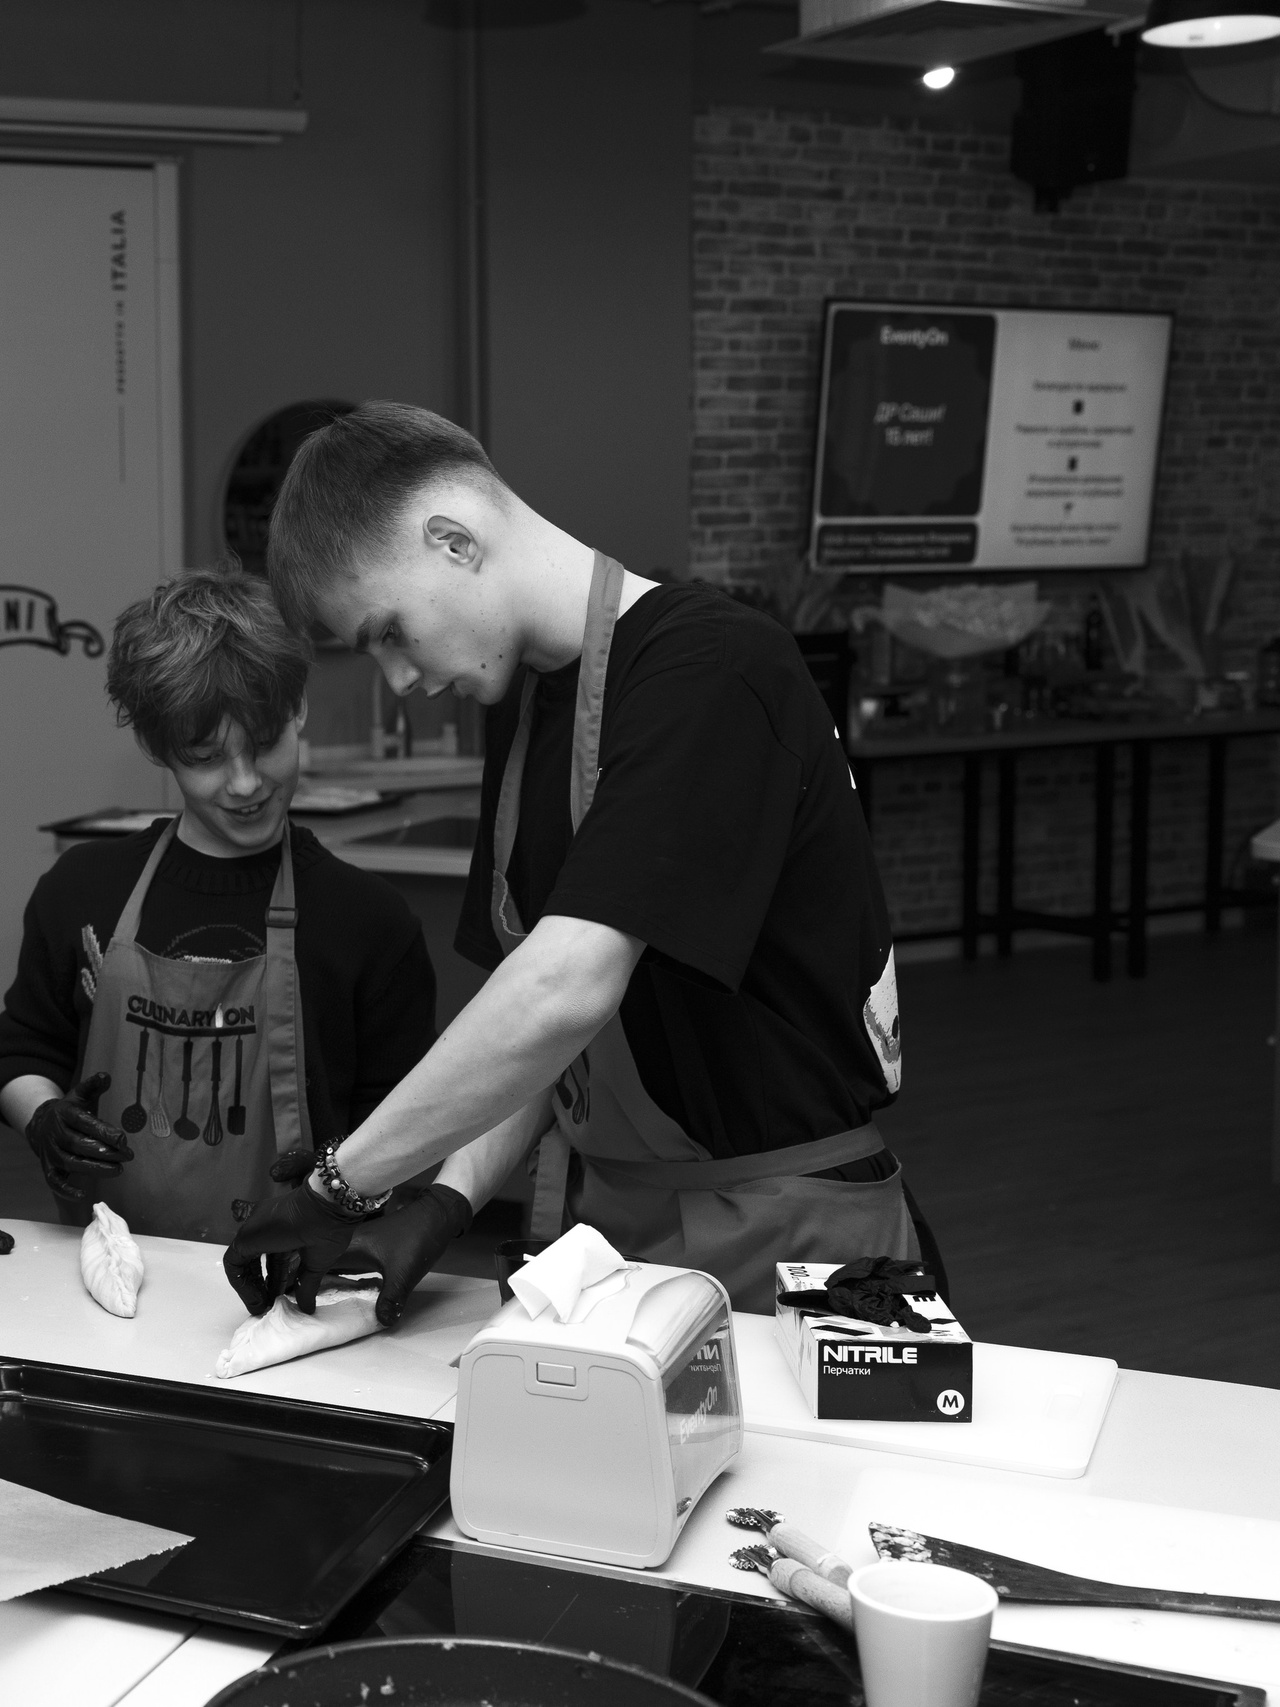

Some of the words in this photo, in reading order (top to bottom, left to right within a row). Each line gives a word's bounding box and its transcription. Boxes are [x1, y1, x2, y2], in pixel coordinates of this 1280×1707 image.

[110, 209, 127, 291] ITALIA
[127, 995, 216, 1027] CULINARY
[224, 1005, 254, 1026] ON
[823, 1345, 918, 1364] NITRILE
[823, 1365, 871, 1377] Перчатки
[942, 1395, 959, 1409] M
